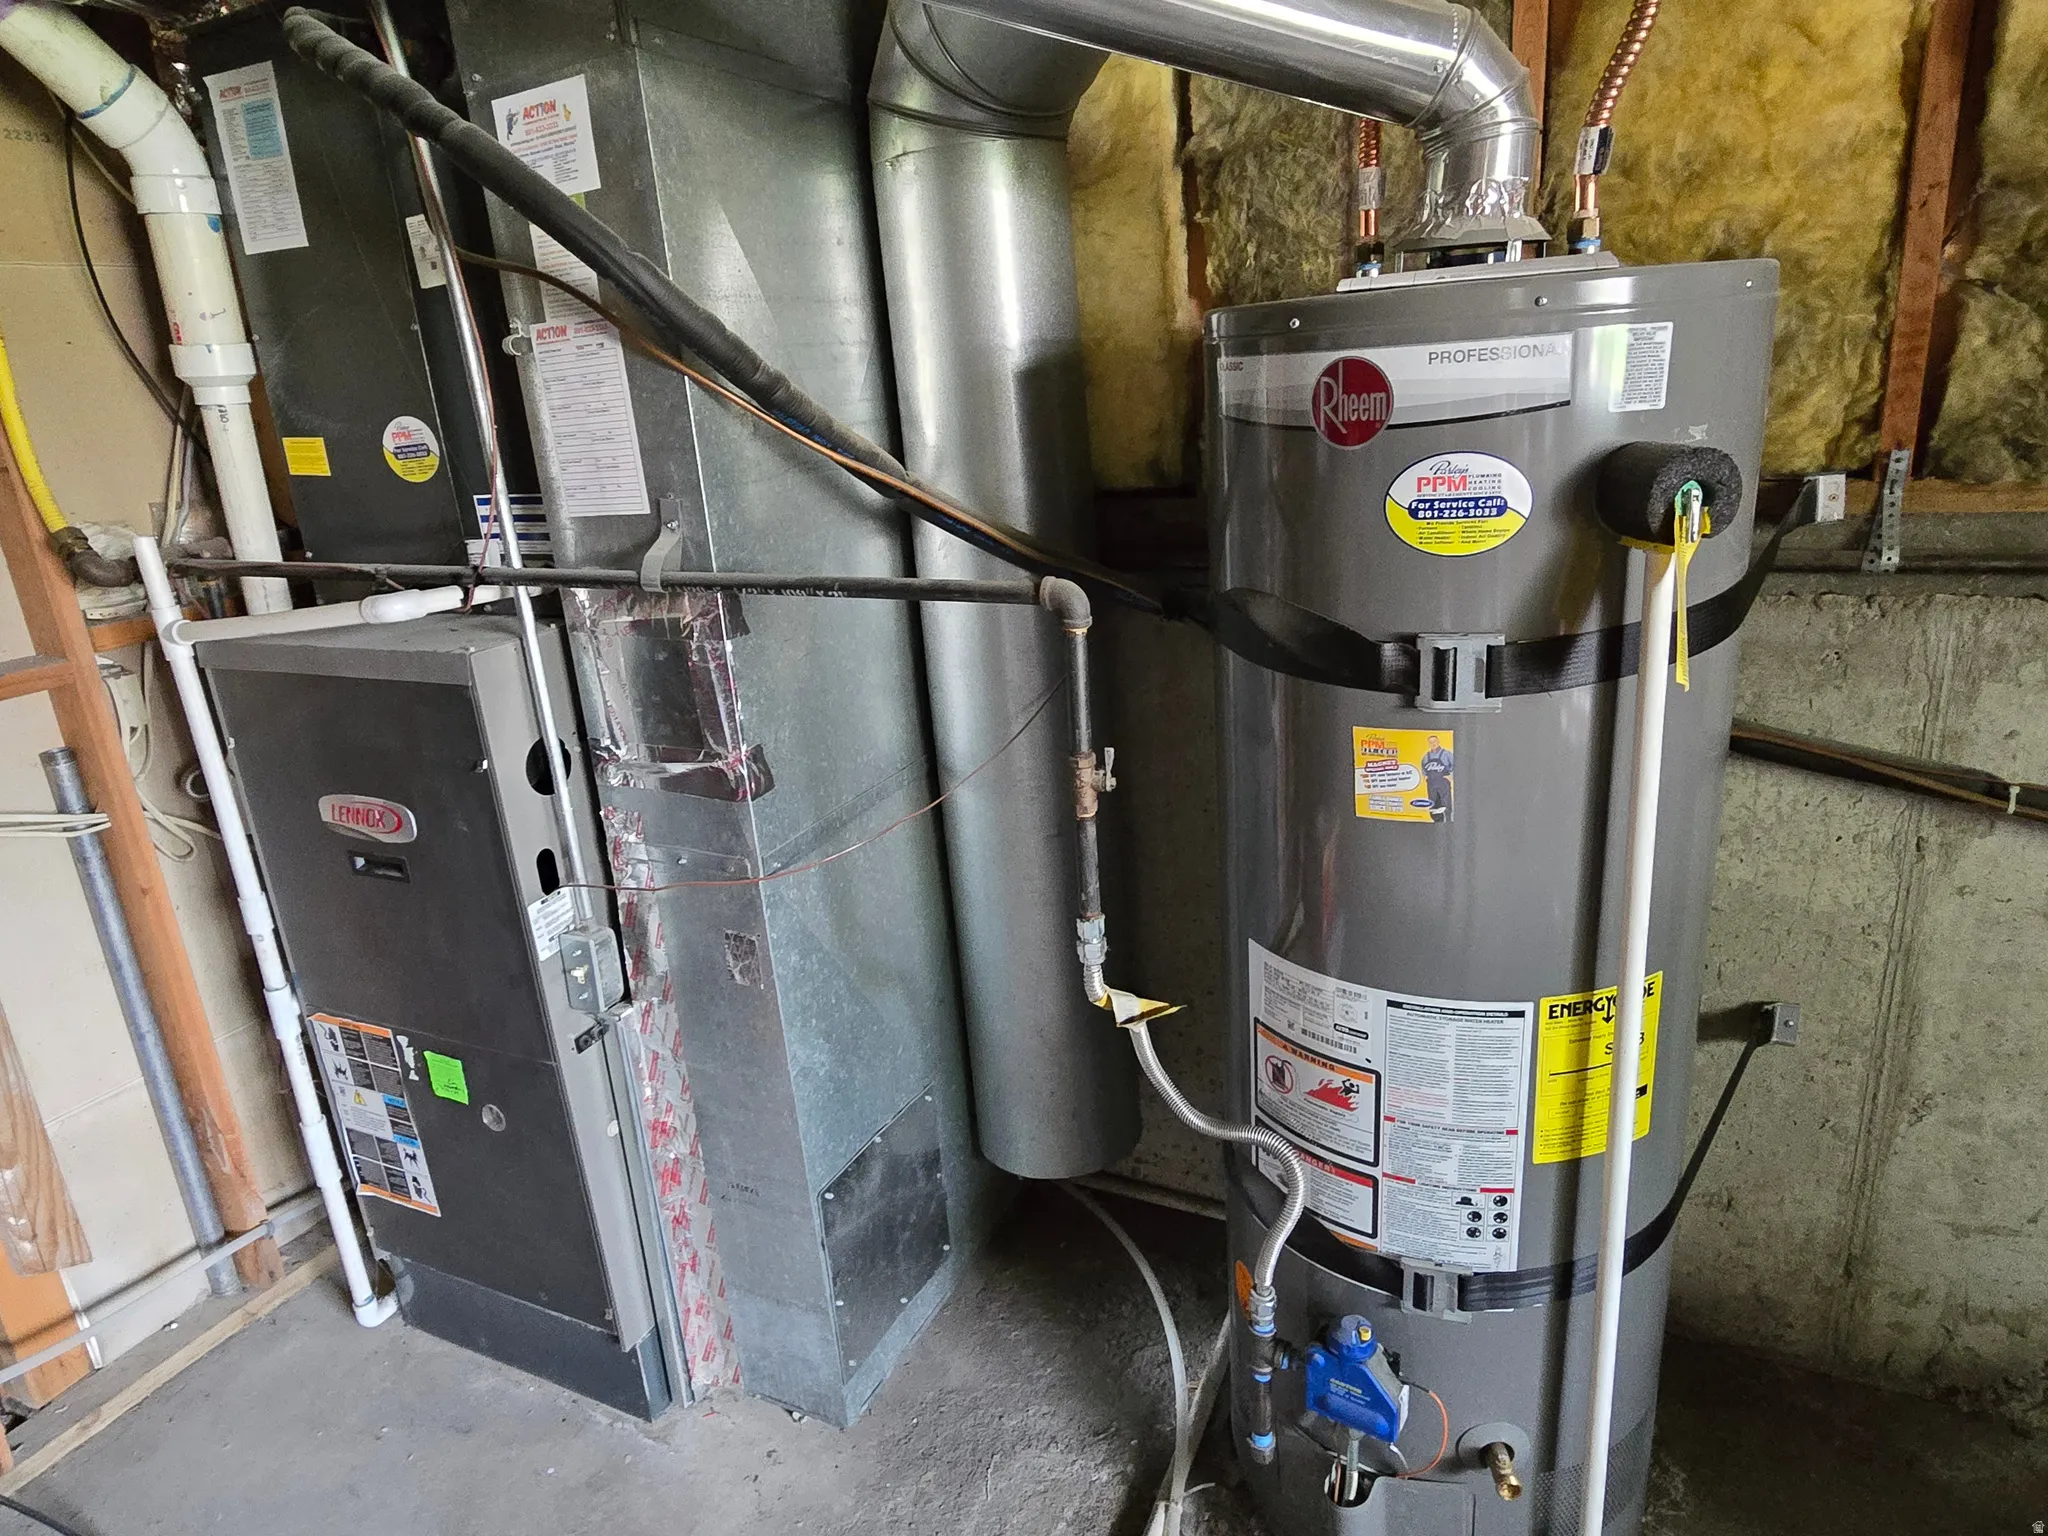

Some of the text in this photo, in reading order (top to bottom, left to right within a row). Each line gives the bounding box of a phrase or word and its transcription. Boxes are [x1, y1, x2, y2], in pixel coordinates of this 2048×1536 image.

[522, 99, 557, 120] ACTION
[536, 325, 568, 341] ACTION
[1320, 360, 1387, 434] Rheem
[1417, 475, 1467, 493] PPM
[1411, 498, 1505, 509] For Service Call:
[1417, 508, 1498, 518] 801-226-3033
[331, 803, 386, 829] LENNOX
[1291, 1045, 1336, 1072] WARNING
